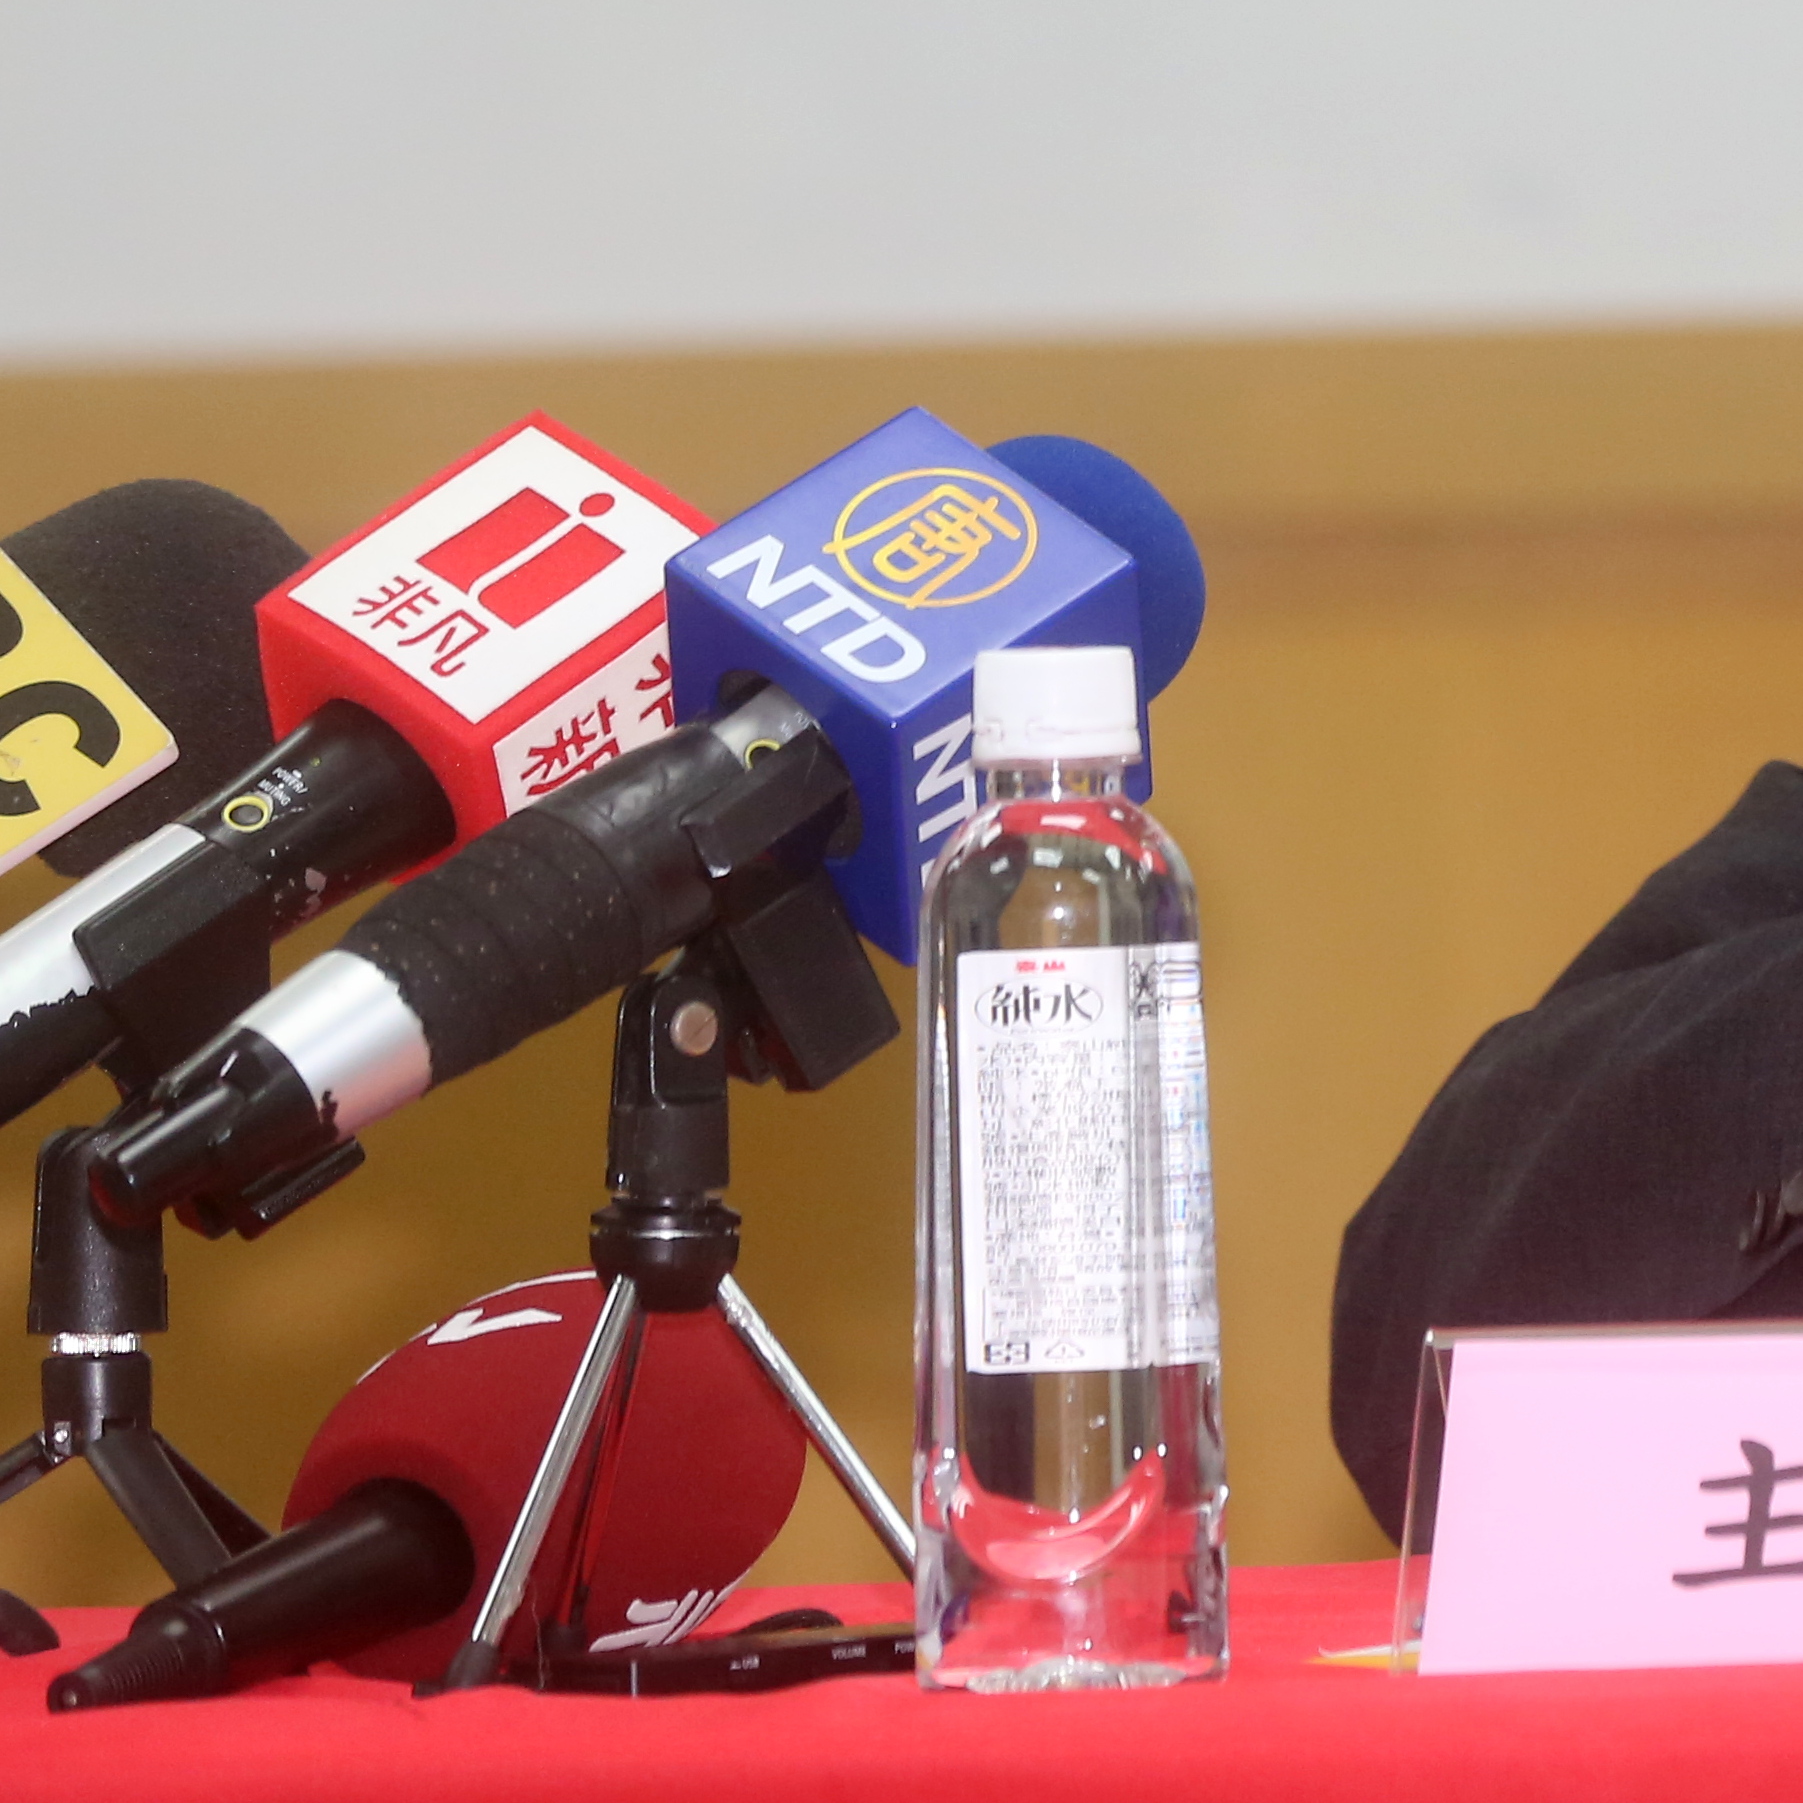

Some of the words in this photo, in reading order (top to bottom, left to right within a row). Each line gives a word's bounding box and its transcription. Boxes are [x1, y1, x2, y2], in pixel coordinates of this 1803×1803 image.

[352, 575, 490, 677] 非凡
[706, 534, 927, 683] NTD
[913, 712, 978, 891] NT
